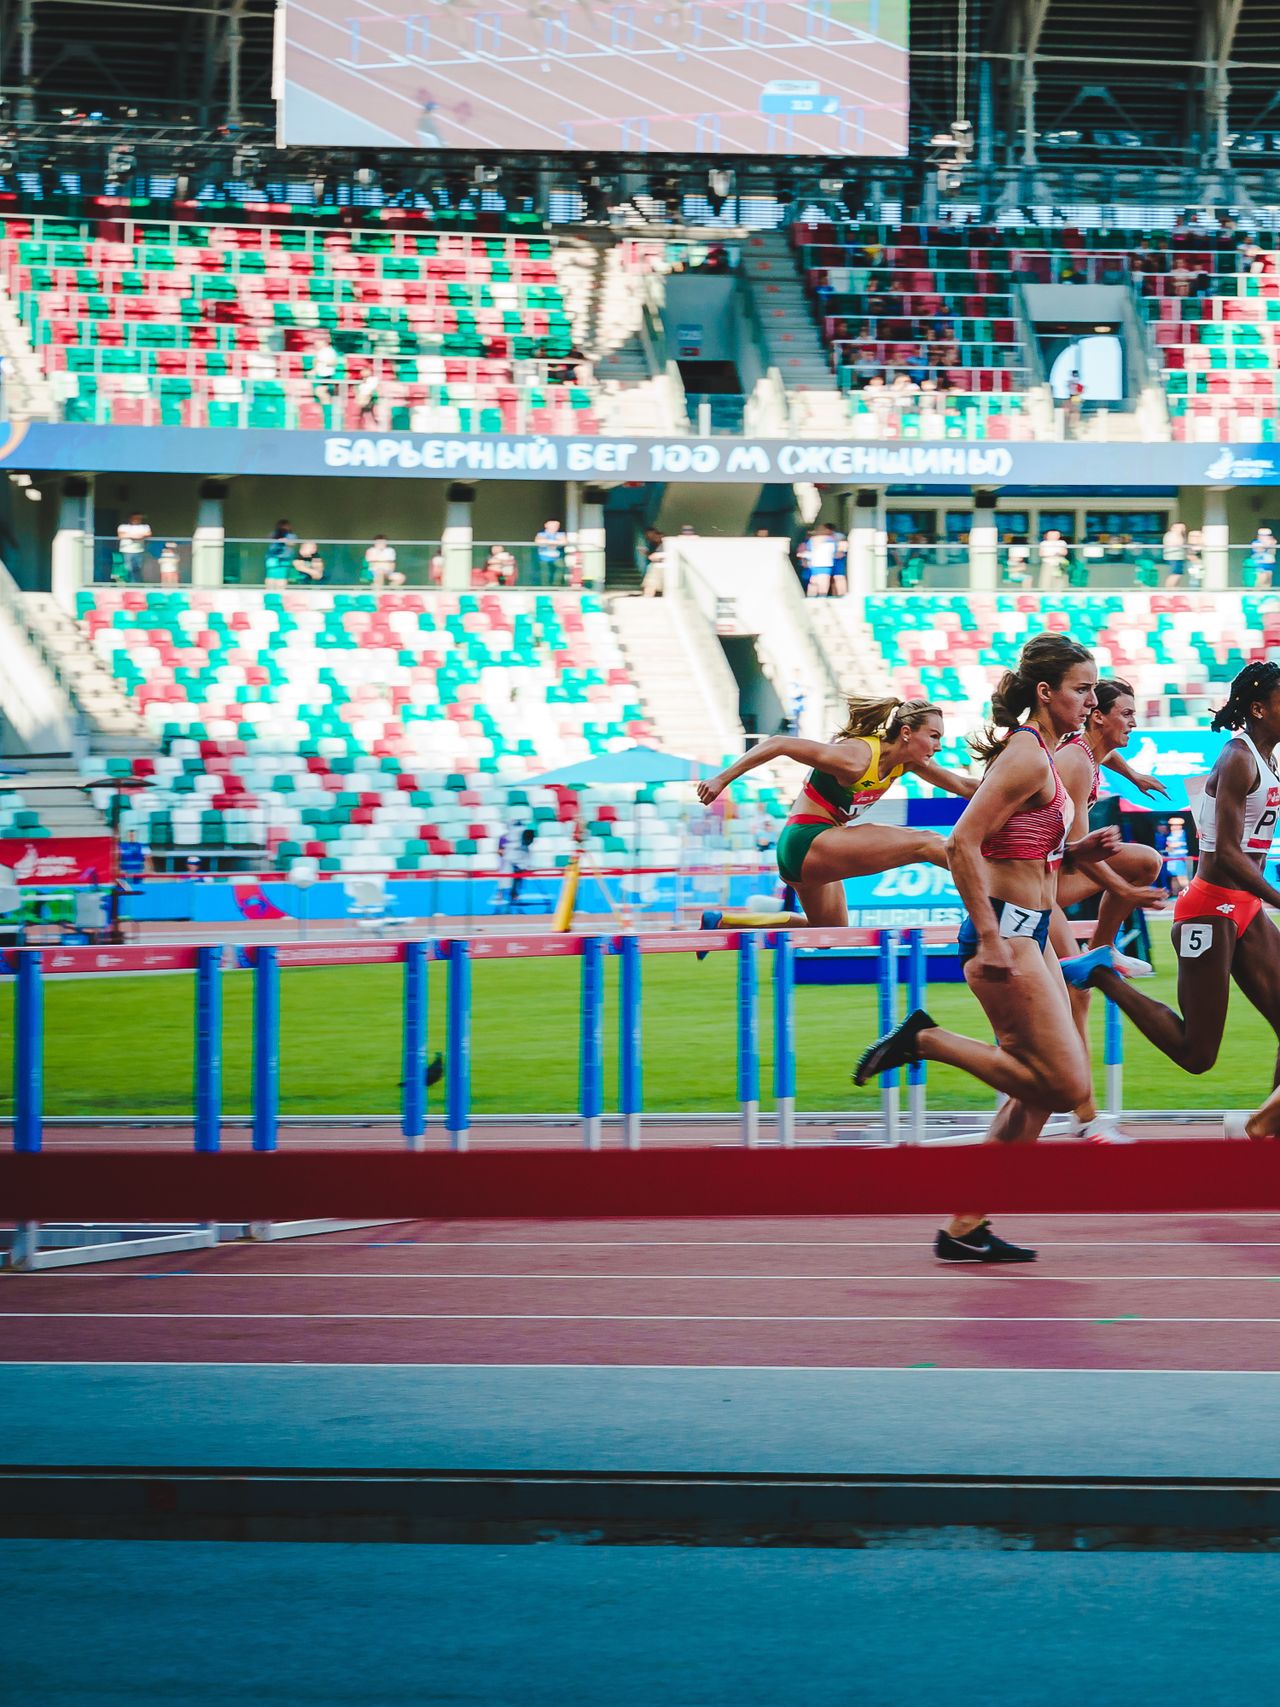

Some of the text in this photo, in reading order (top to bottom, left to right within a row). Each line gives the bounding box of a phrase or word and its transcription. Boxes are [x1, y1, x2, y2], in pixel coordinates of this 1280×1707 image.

[324, 435, 558, 470] БАРЬЕРНЫЙ
[566, 443, 637, 472] БЕГ
[648, 444, 720, 473] 100
[1013, 909, 1030, 933] 7
[1189, 930, 1203, 951] 5
